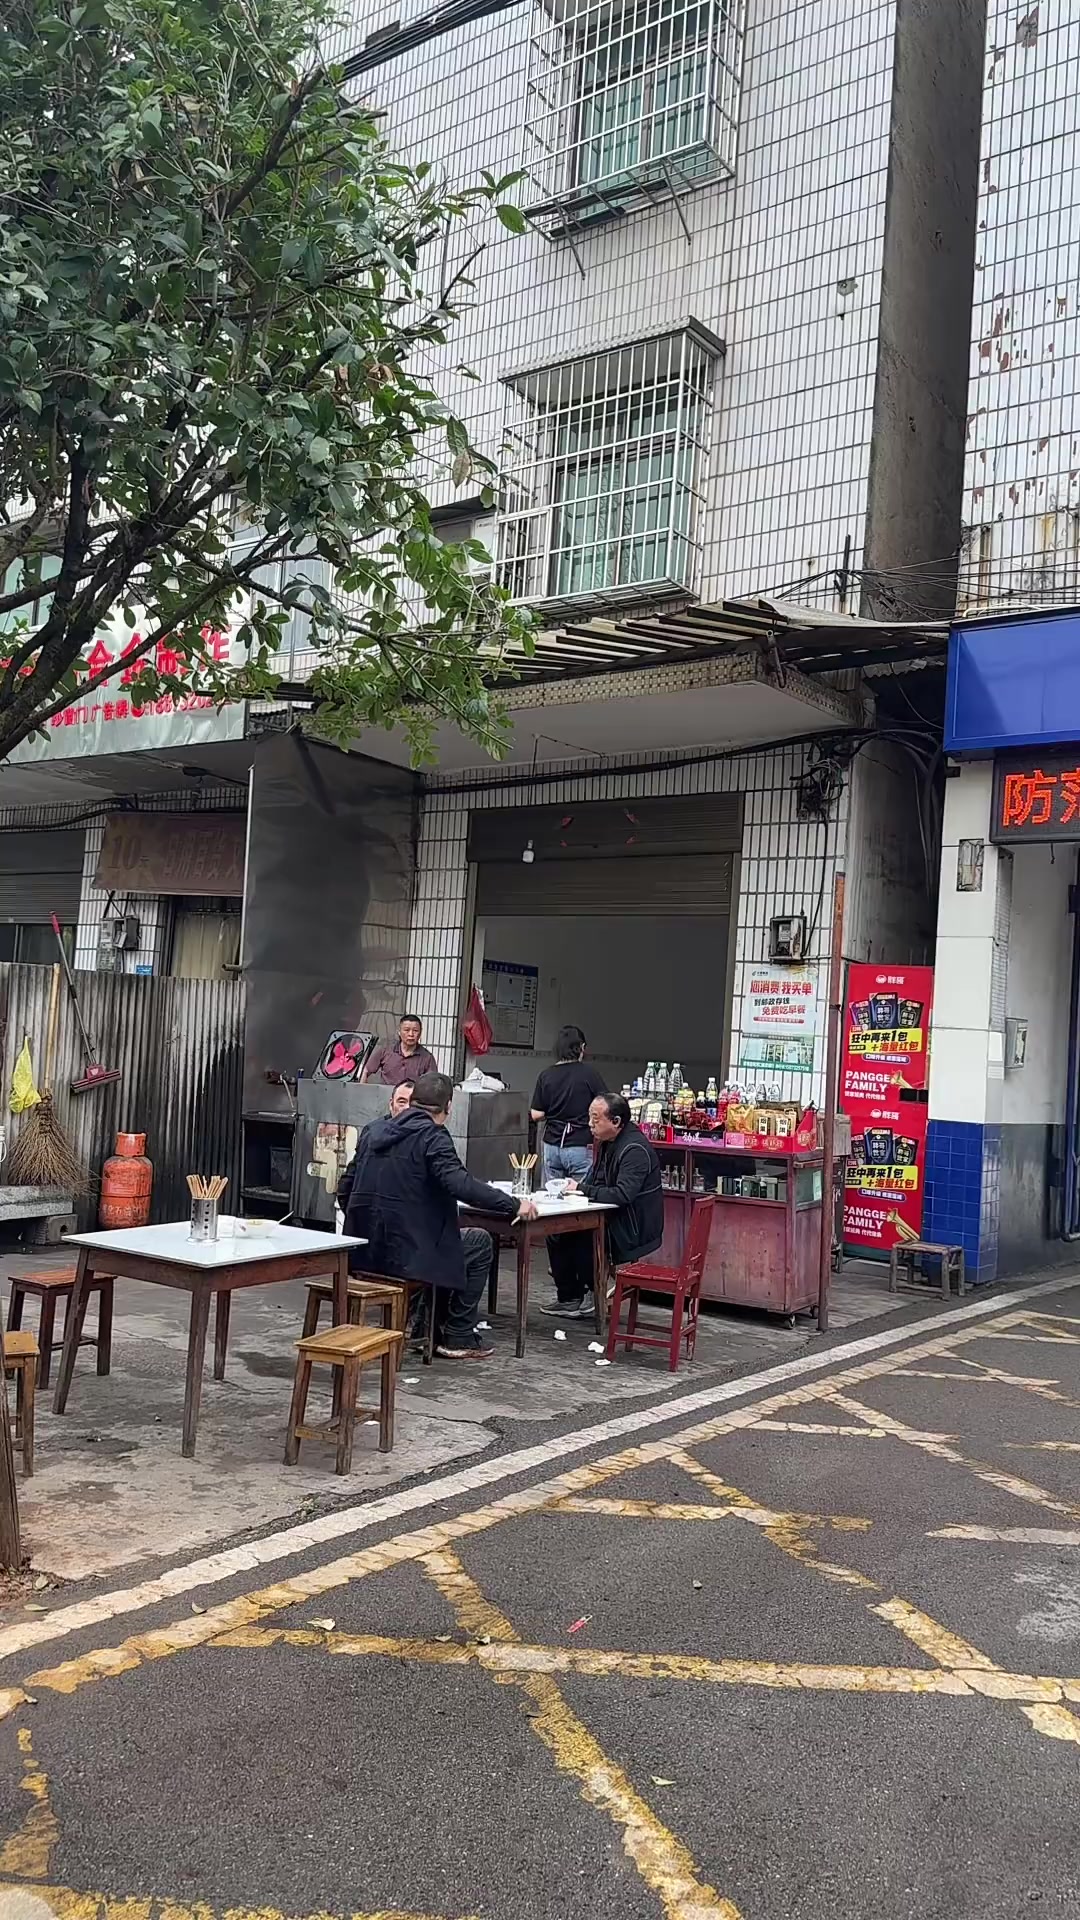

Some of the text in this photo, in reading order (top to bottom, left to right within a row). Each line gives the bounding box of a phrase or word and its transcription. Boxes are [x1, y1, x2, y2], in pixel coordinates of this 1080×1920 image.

[781, 980, 813, 996] 我买单
[761, 1004, 806, 1016] 免费吃早餐
[845, 1070, 891, 1083] PANGGE
[844, 1080, 888, 1093] FAMILY
